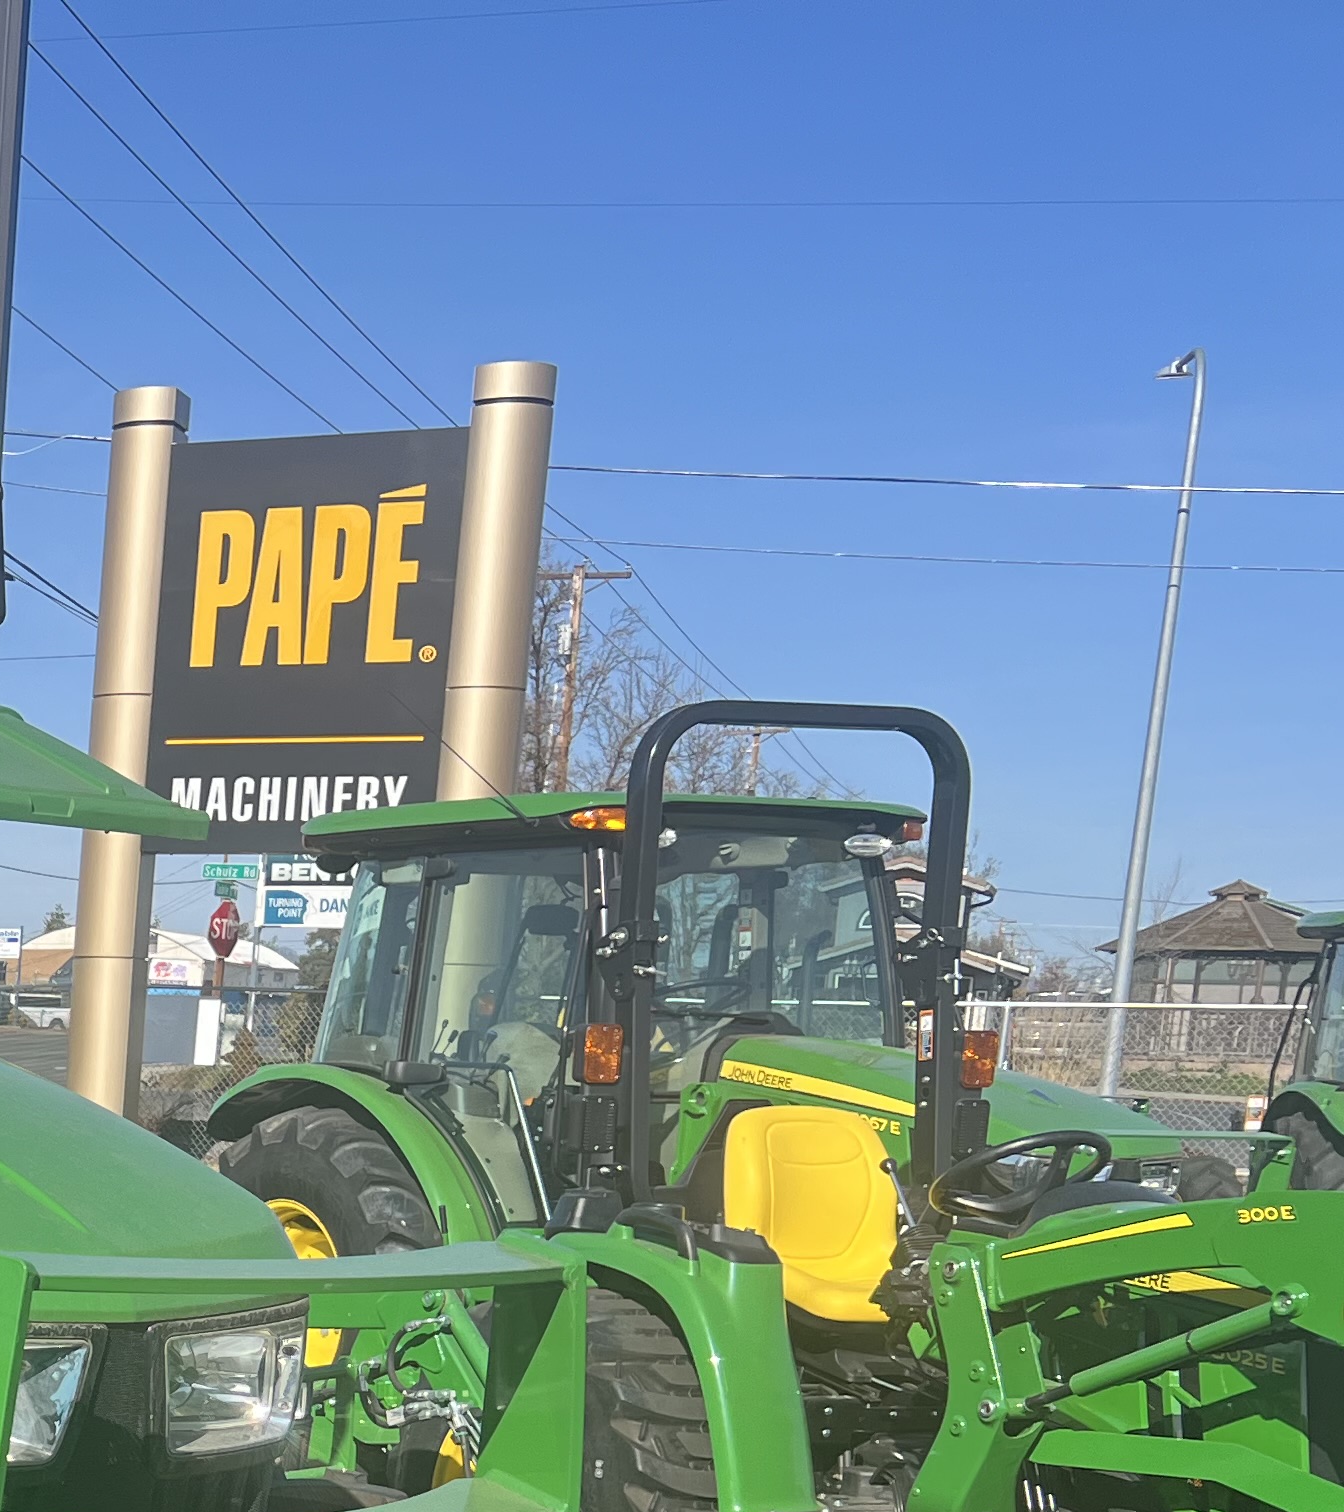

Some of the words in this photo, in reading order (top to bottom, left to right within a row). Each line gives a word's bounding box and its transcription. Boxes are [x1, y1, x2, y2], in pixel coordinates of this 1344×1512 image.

[189, 483, 427, 667] PAPÉ
[171, 775, 408, 822] MACHINERY
[243, 866, 256, 878] Rd
[268, 897, 304, 908] TURNING
[277, 908, 303, 918] POINT
[728, 1065, 756, 1082] JOHN
[756, 1070, 793, 1089] DEERE
[890, 1120, 901, 1136] E
[1237, 1206, 1279, 1225] 300
[1280, 1204, 1296, 1221] E
[1272, 1356, 1286, 1375] E
